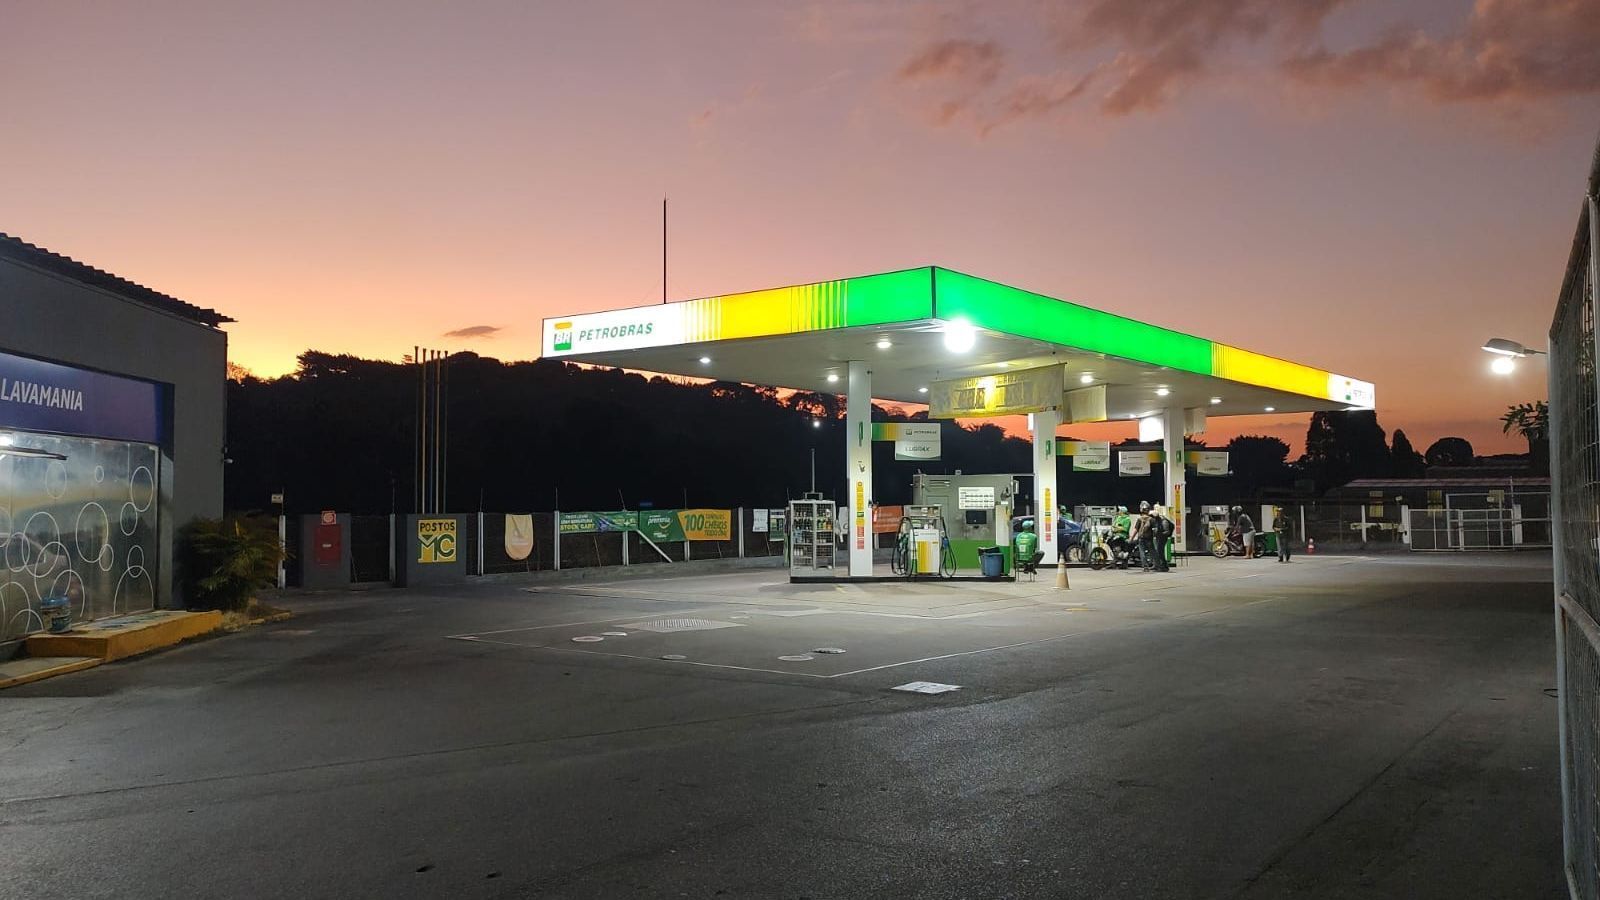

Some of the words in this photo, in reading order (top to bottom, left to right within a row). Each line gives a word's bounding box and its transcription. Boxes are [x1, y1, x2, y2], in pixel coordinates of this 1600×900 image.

[579, 322, 653, 341] PETROBRAS
[1, 377, 83, 411] LAVAMANIA
[420, 522, 455, 532] POSTOS
[684, 513, 704, 531] 100
[417, 533, 455, 561] MC
